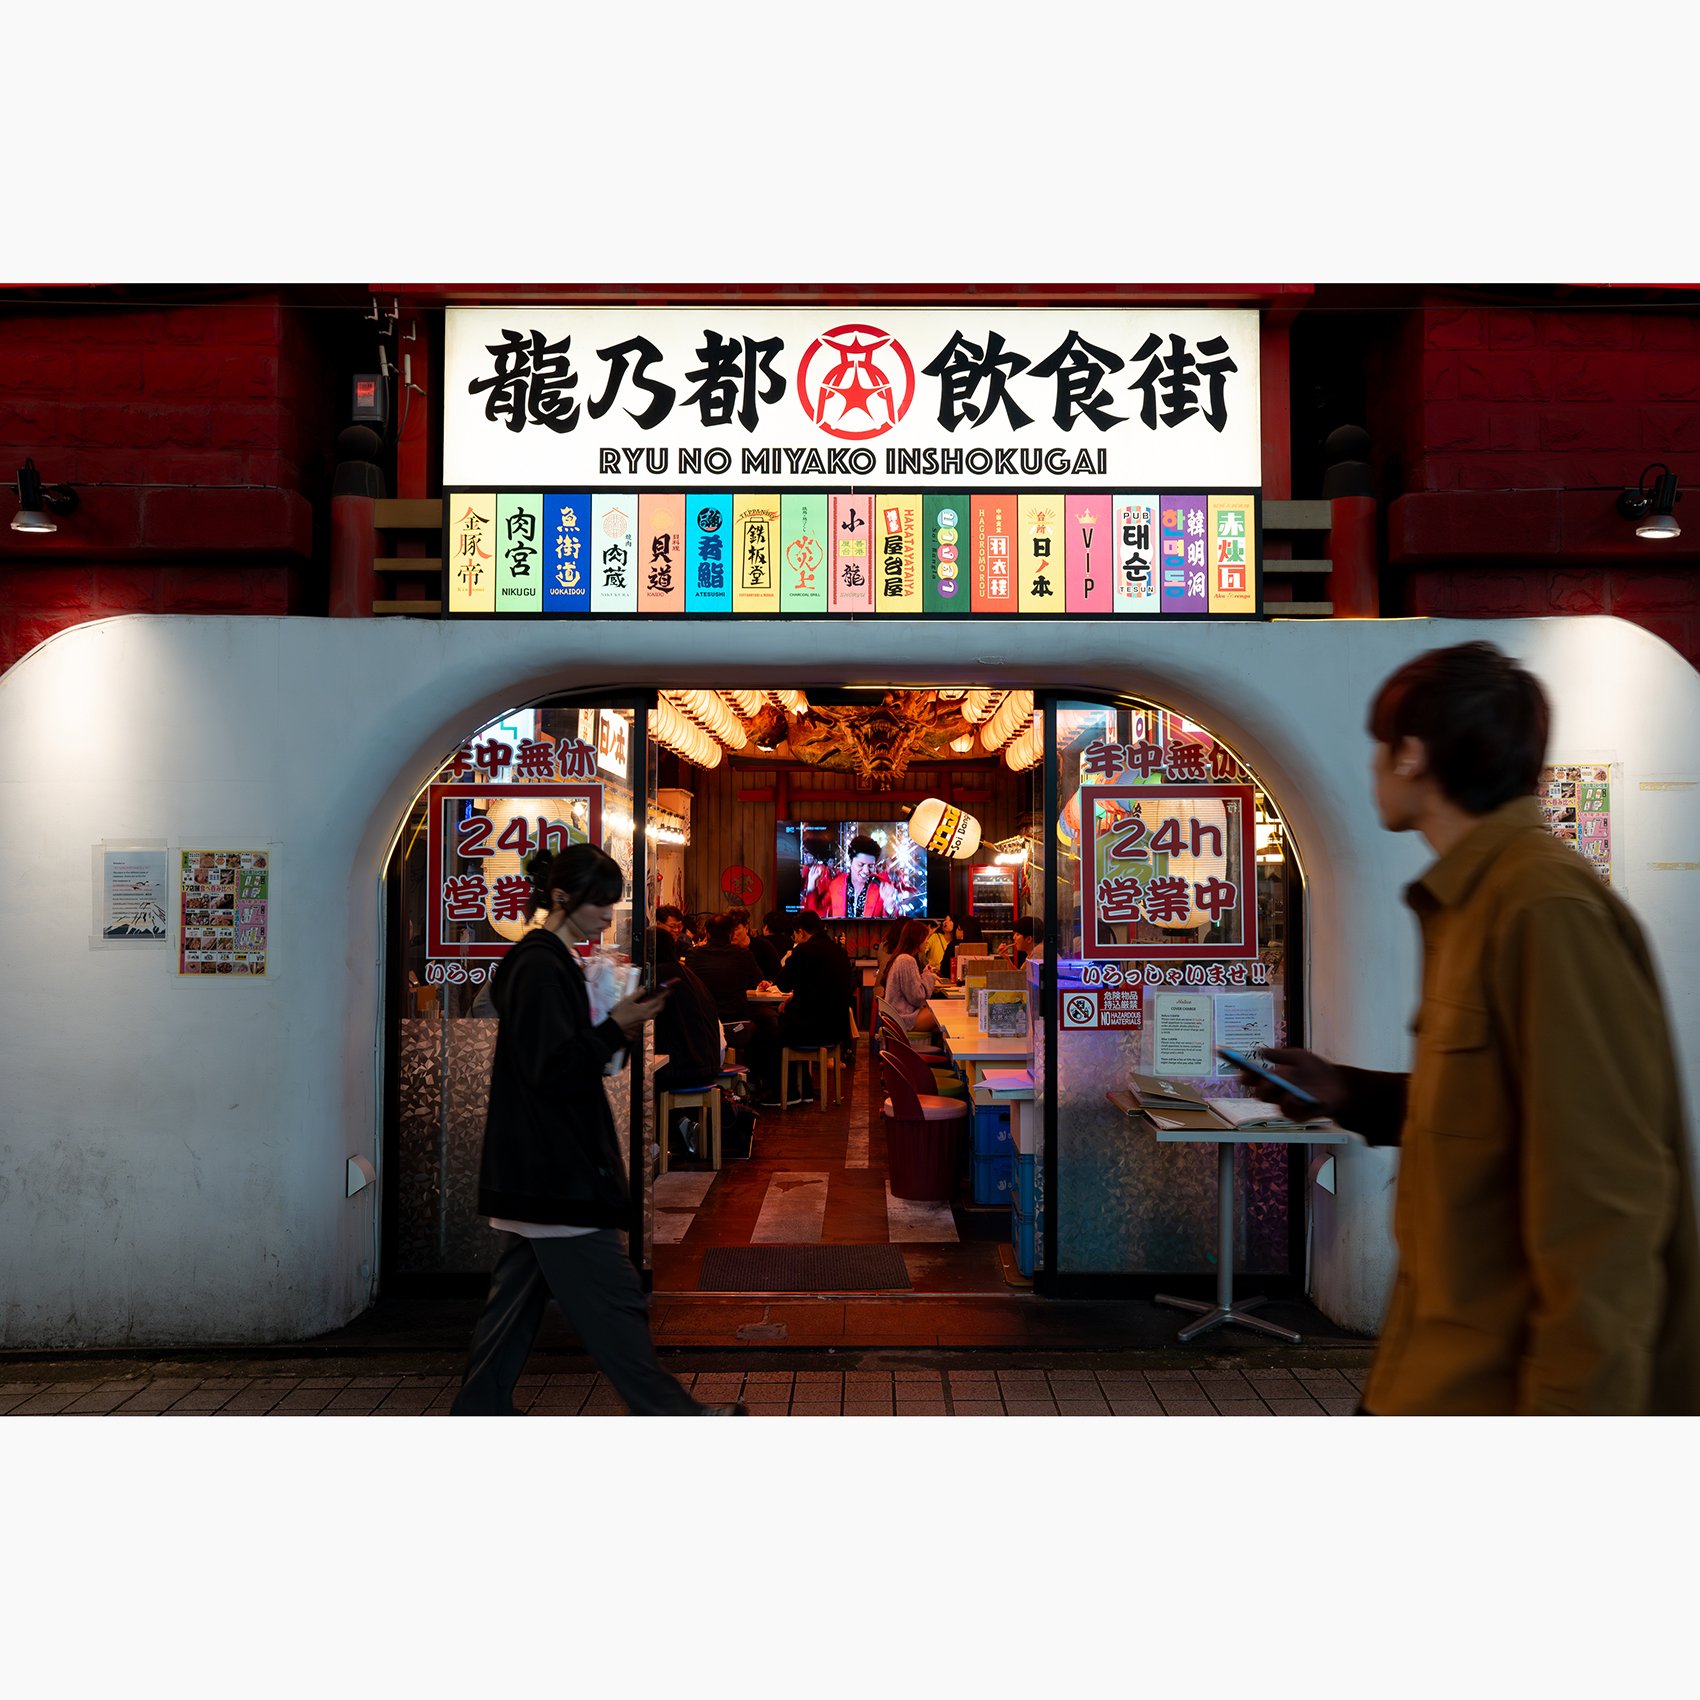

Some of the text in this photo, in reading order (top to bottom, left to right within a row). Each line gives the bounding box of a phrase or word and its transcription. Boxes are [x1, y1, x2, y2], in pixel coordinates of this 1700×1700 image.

[468, 328, 1239, 434] 龍乃都 飲食街
[599, 447, 1108, 475] RYU NO MIYAKO INSHOKUGAI
[504, 506, 538, 578] 肉宮
[1036, 511, 1046, 534] 台所
[1123, 512, 1149, 520] PUB
[453, 506, 493, 596] 金豚帝
[555, 506, 581, 588] 魚街道
[602, 543, 628, 589] 肉蔵
[646, 533, 675, 594] 貝道
[883, 535, 903, 597] 屋台屋
[904, 509, 915, 597] HAKATAYATAIYA
[1030, 537, 1054, 597] 日ノ本
[1082, 528, 1095, 599] VIP
[1122, 524, 1151, 582] 태순
[1162, 508, 1186, 599] 한명동
[1186, 508, 1206, 598] 韓明洞
[501, 588, 537, 597] NIKUGU
[549, 588, 586, 596] UOKAIDOU
[1110, 815, 1224, 861] 24h
[1097, 876, 1237, 924] 営業中
[1100, 1011, 1111, 1026] NO
[1104, 991, 1139, 1000] 危険物品
